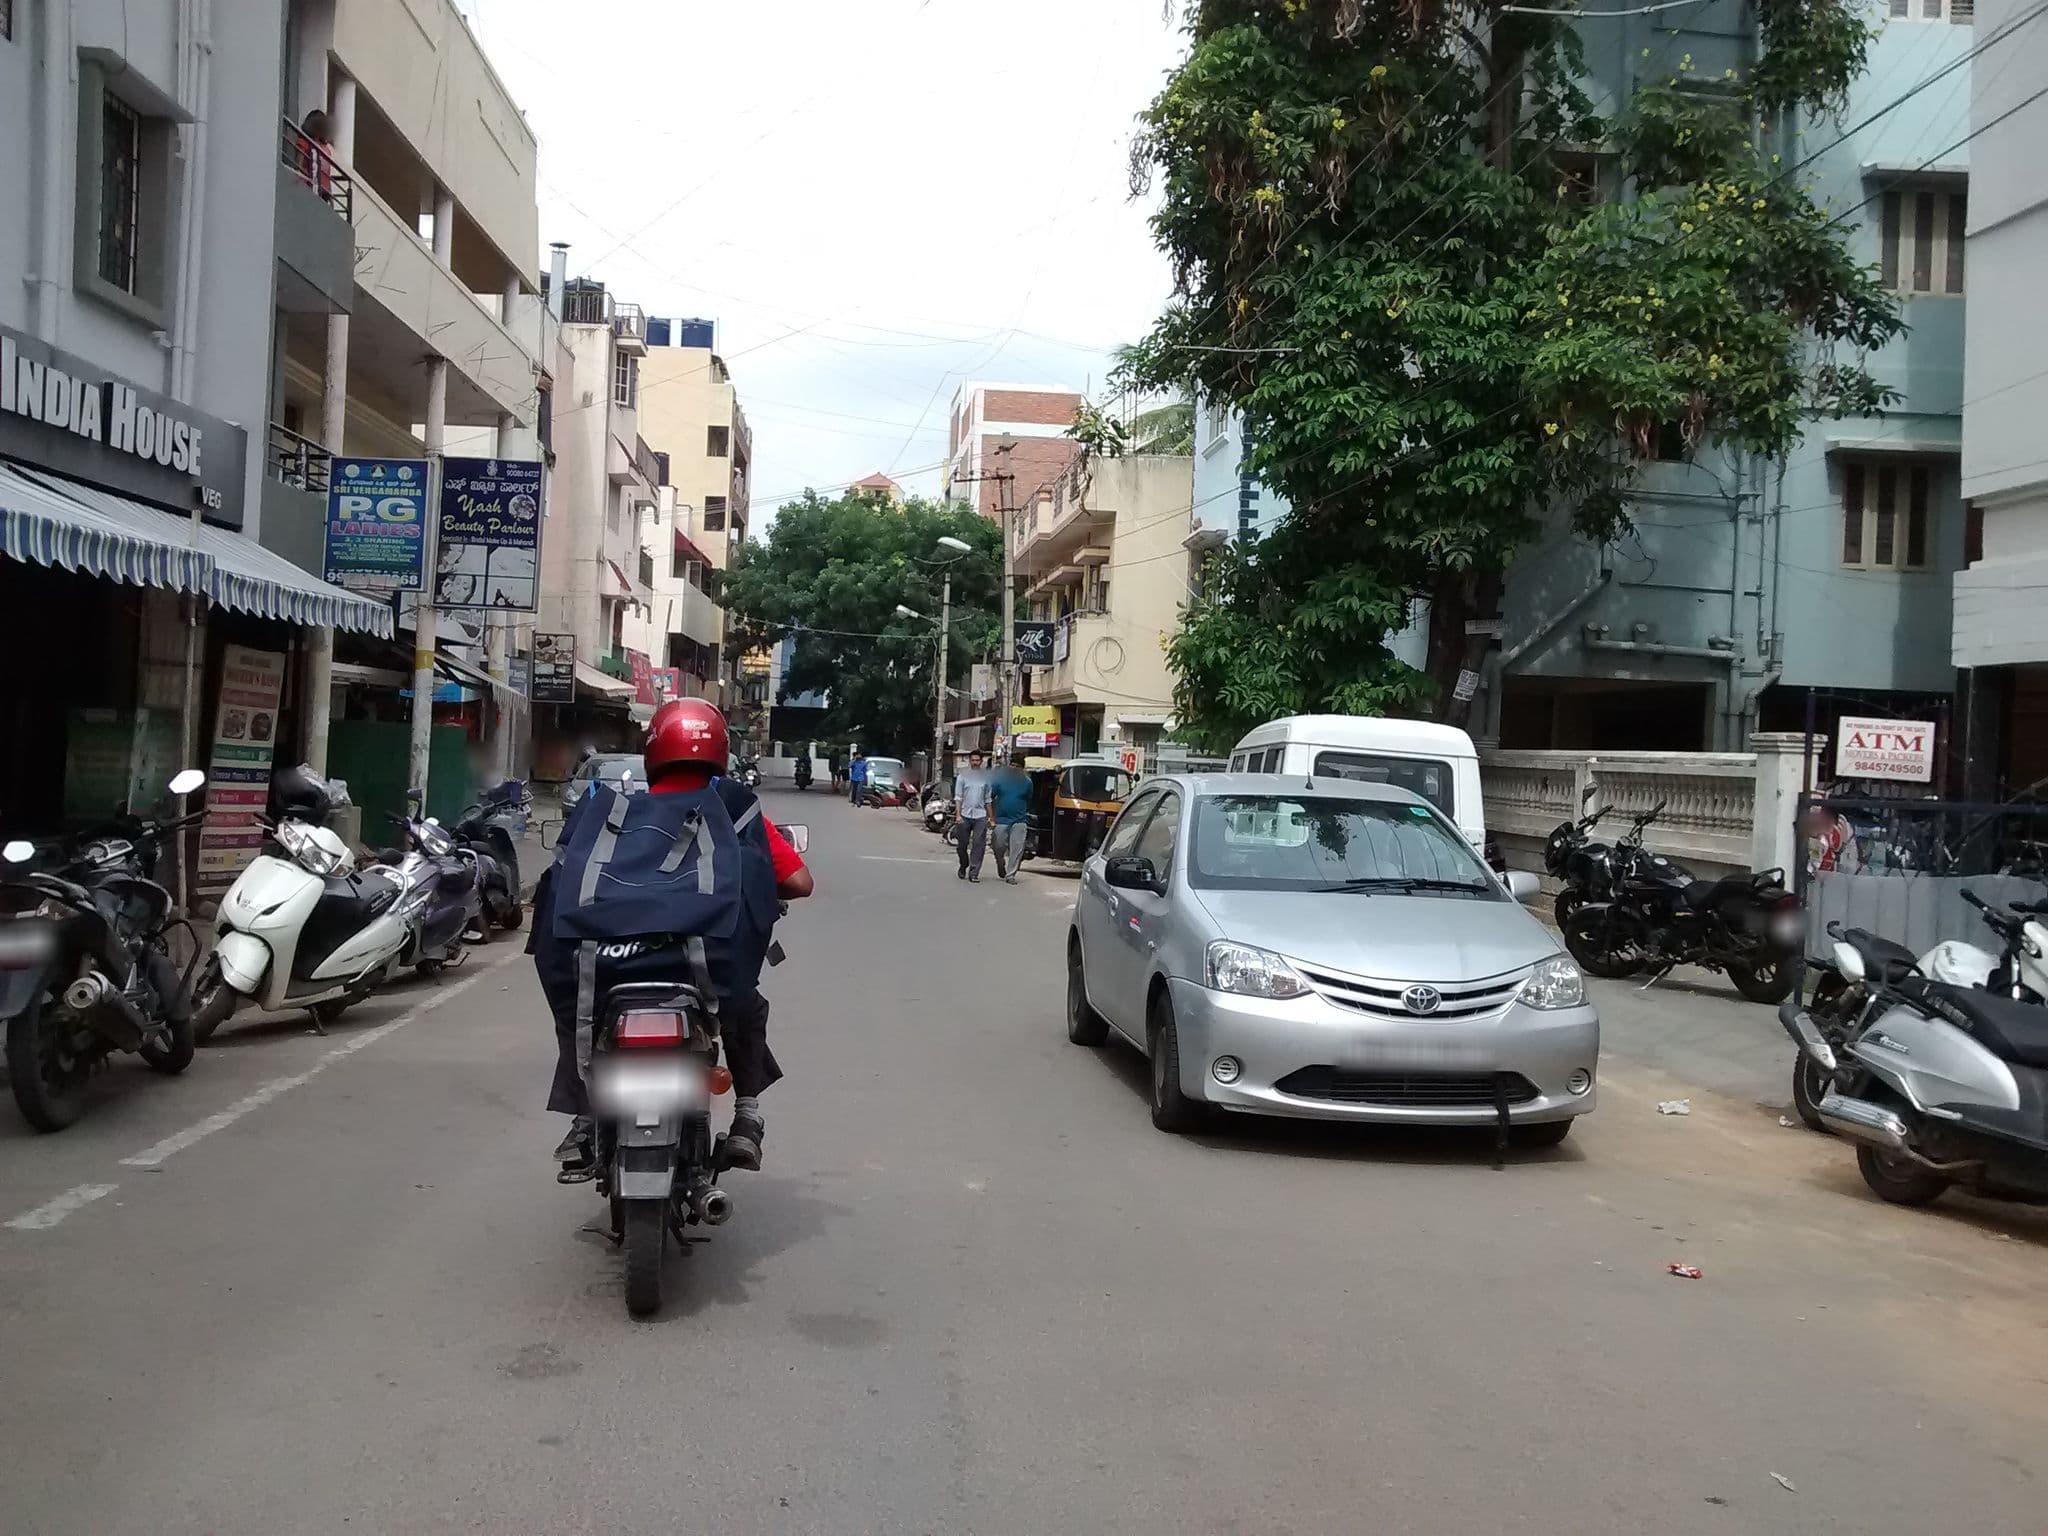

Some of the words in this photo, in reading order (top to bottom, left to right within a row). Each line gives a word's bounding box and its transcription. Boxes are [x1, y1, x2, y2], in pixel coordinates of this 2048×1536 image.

[0, 336, 102, 442] INDIA
[108, 380, 203, 477] HOUSE
[201, 486, 222, 510] VEG
[334, 485, 350, 494] SRI
[339, 495, 418, 522] PG
[457, 494, 502, 518] Yash
[330, 520, 421, 538] LADIES
[442, 514, 485, 535] Beauty
[487, 517, 535, 535] Parlour
[363, 537, 405, 545] SHARING
[1012, 714, 1035, 726] dea
[1845, 731, 1925, 752] ATM
